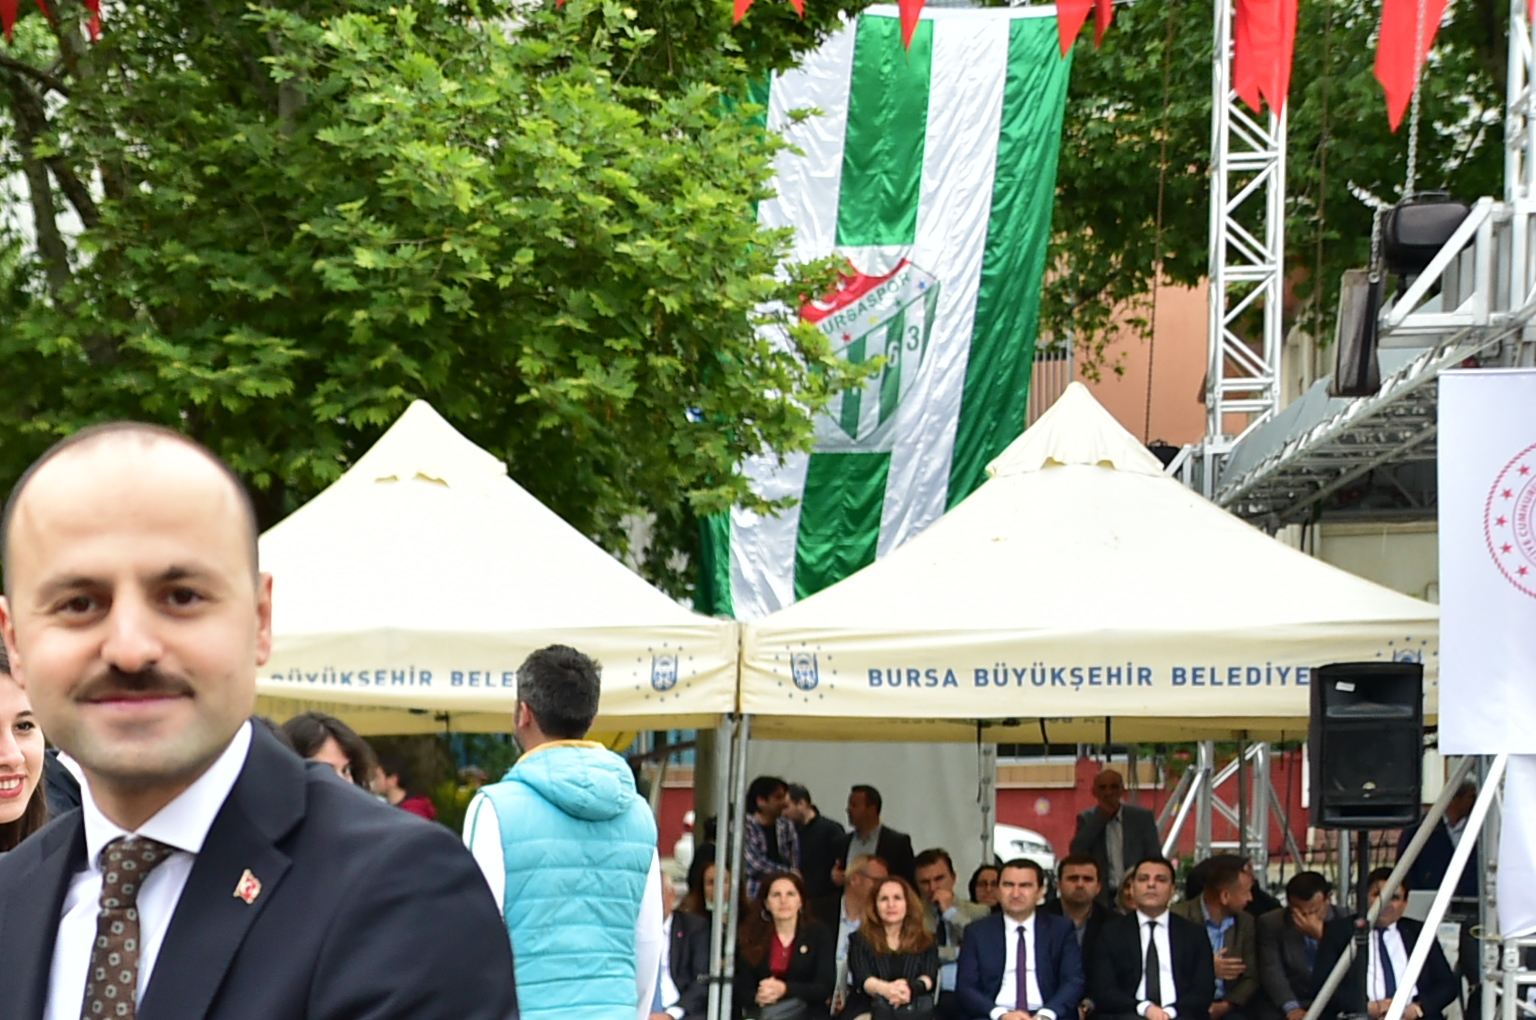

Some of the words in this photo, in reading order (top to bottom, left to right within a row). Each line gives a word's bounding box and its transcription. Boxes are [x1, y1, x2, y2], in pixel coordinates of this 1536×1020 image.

[821, 271, 911, 335] URSASPOR
[1518, 484, 1536, 537] CUMHUR
[450, 670, 514, 688] BELE
[867, 668, 959, 688] BURSA
[974, 661, 1154, 691] BÜYÜKŞEHİR
[1171, 662, 1310, 688] BELEDİYE
